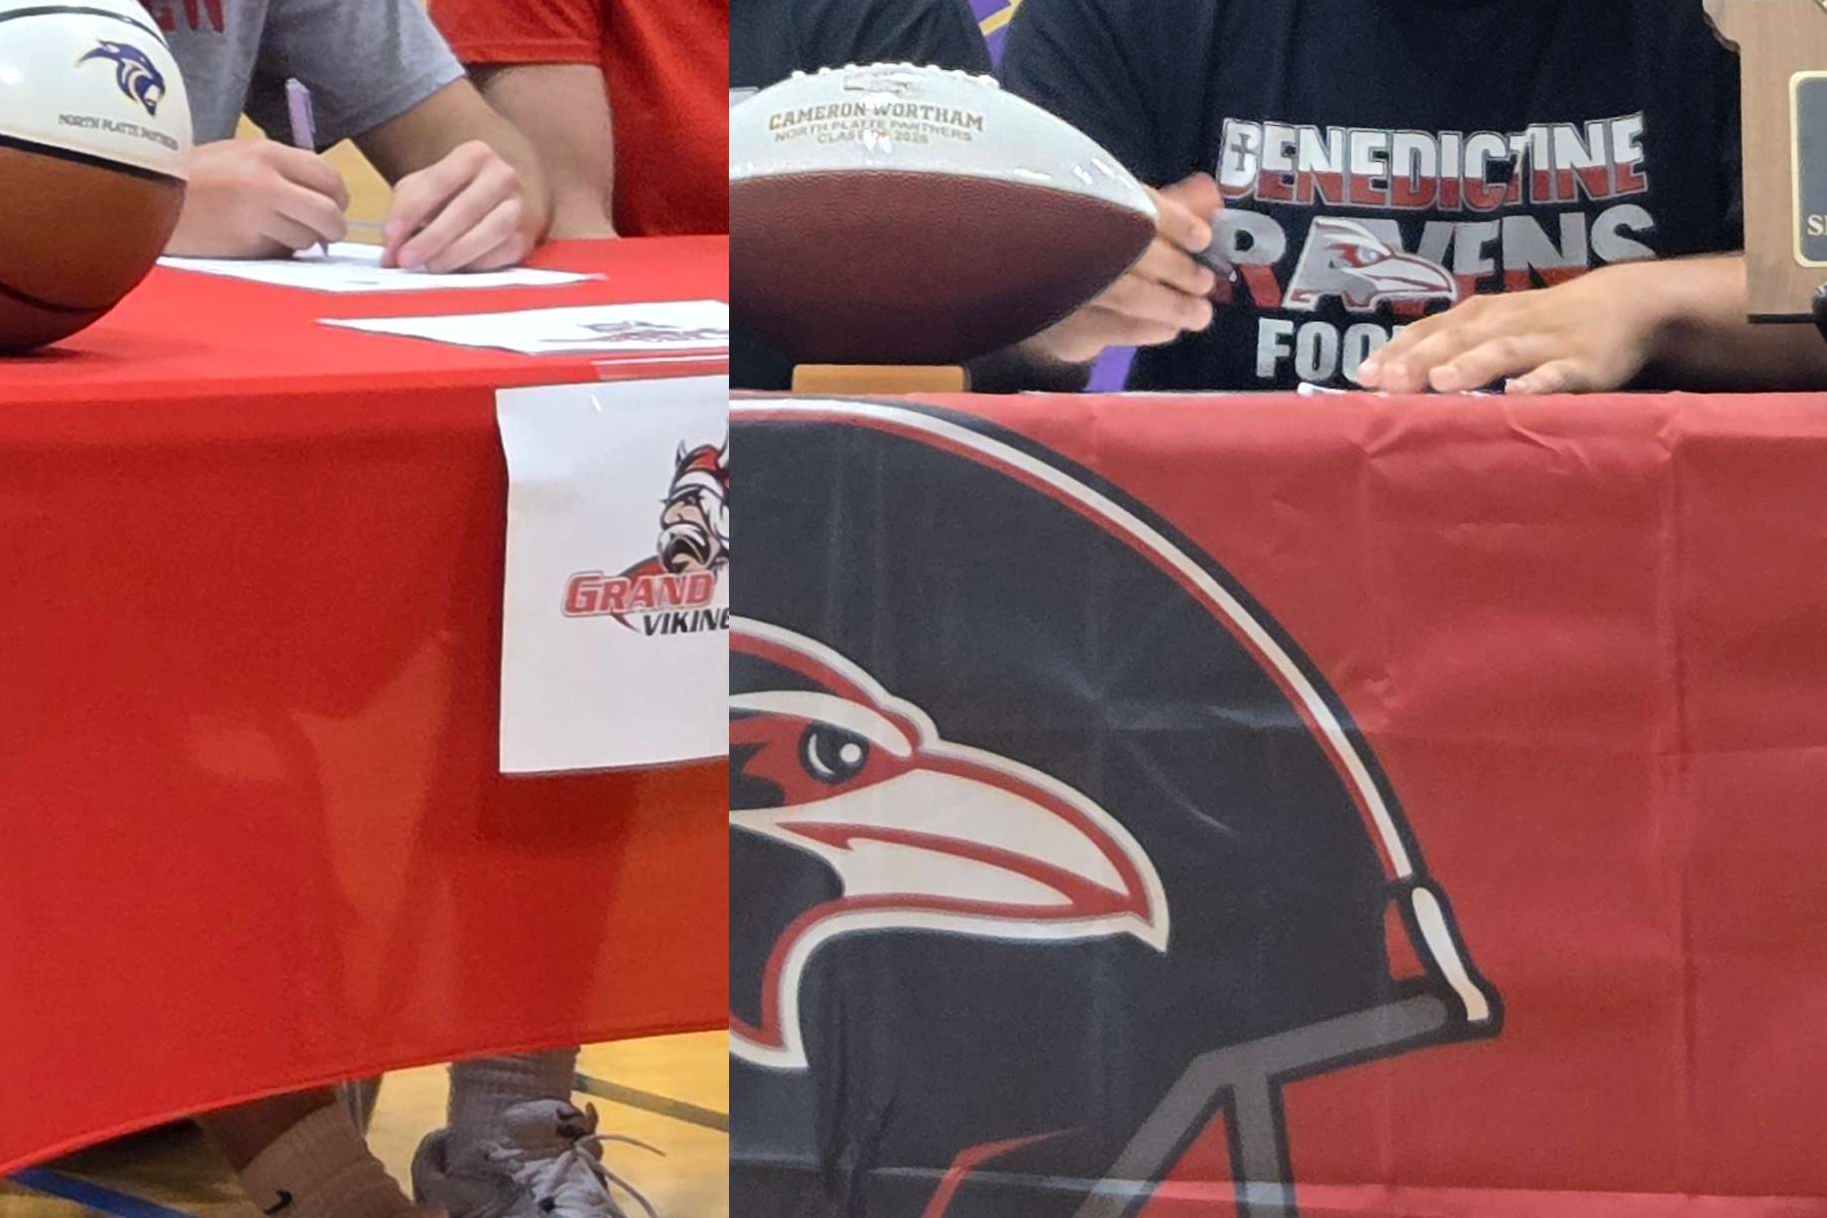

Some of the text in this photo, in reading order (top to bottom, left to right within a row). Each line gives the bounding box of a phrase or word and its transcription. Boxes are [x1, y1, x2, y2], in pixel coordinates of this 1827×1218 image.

[768, 102, 984, 132] CAMERON WORTHAM
[774, 124, 828, 142] NORTH
[831, 119, 887, 131] PLATTE
[890, 120, 973, 142] PANTHERS
[1217, 110, 1648, 212] BENEDICTINE
[563, 571, 714, 616] GRAND
